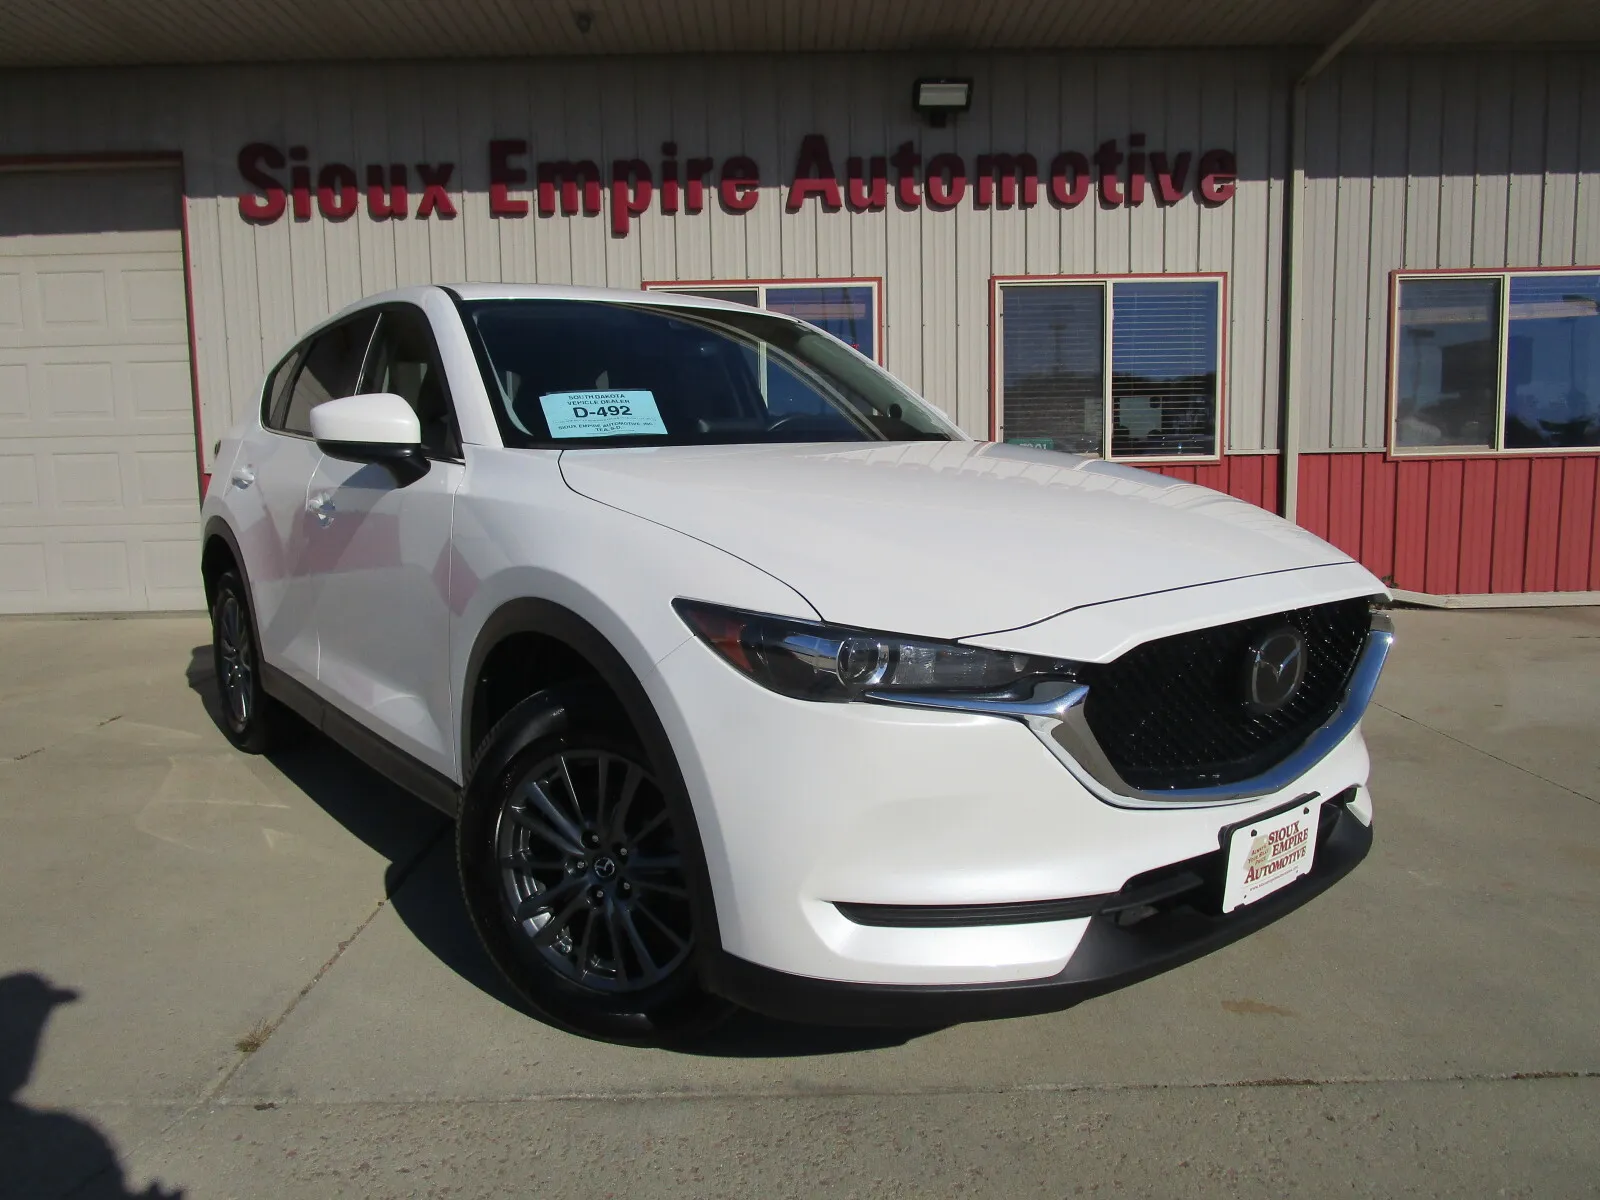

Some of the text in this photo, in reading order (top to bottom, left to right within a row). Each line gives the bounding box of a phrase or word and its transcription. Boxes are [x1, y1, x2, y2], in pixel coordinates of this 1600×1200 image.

[238, 133, 1237, 235] Sioux Empire Automotive
[573, 405, 633, 418] D-492
[1268, 820, 1300, 846] SIOUX
[1271, 828, 1309, 857] EMPIRE
[1244, 846, 1307, 884] AUTOMOTIVE
